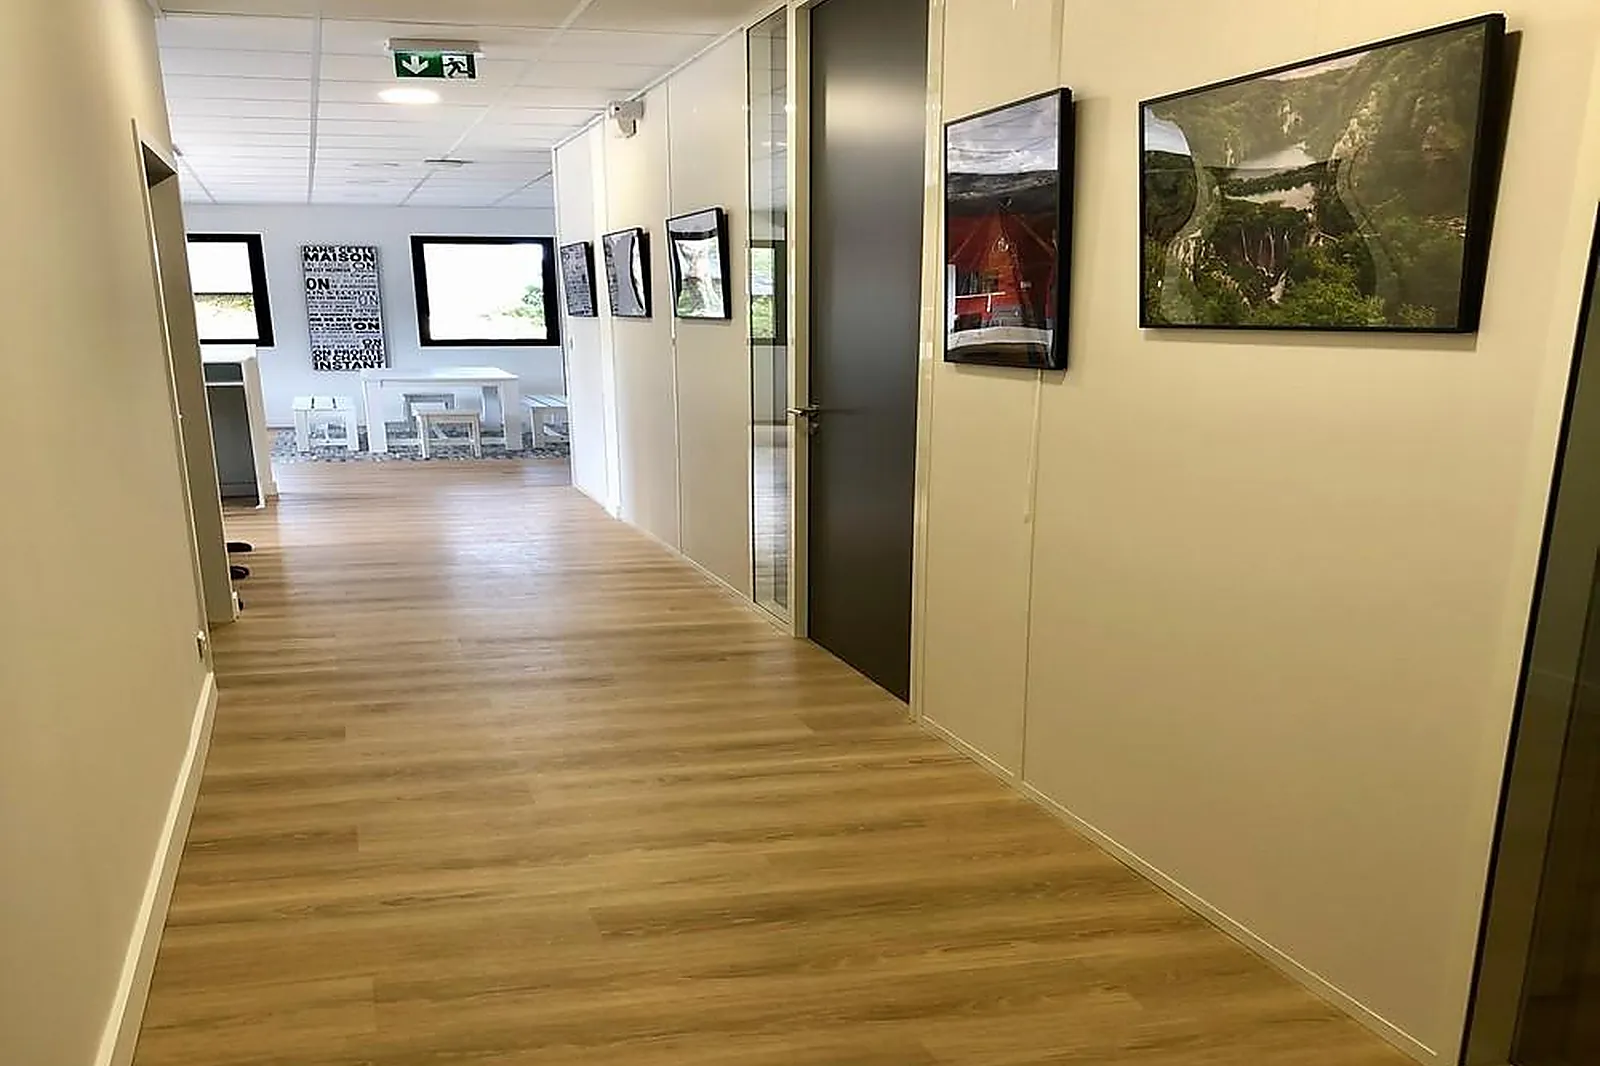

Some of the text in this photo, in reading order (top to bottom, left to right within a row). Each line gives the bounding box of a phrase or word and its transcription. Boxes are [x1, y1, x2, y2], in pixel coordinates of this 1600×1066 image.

[303, 253, 375, 261] MAISON
[353, 262, 375, 270] ON
[306, 278, 330, 290] ON
[358, 295, 379, 305] ON
[353, 322, 380, 330] ON
[314, 361, 384, 370] INSTANT
